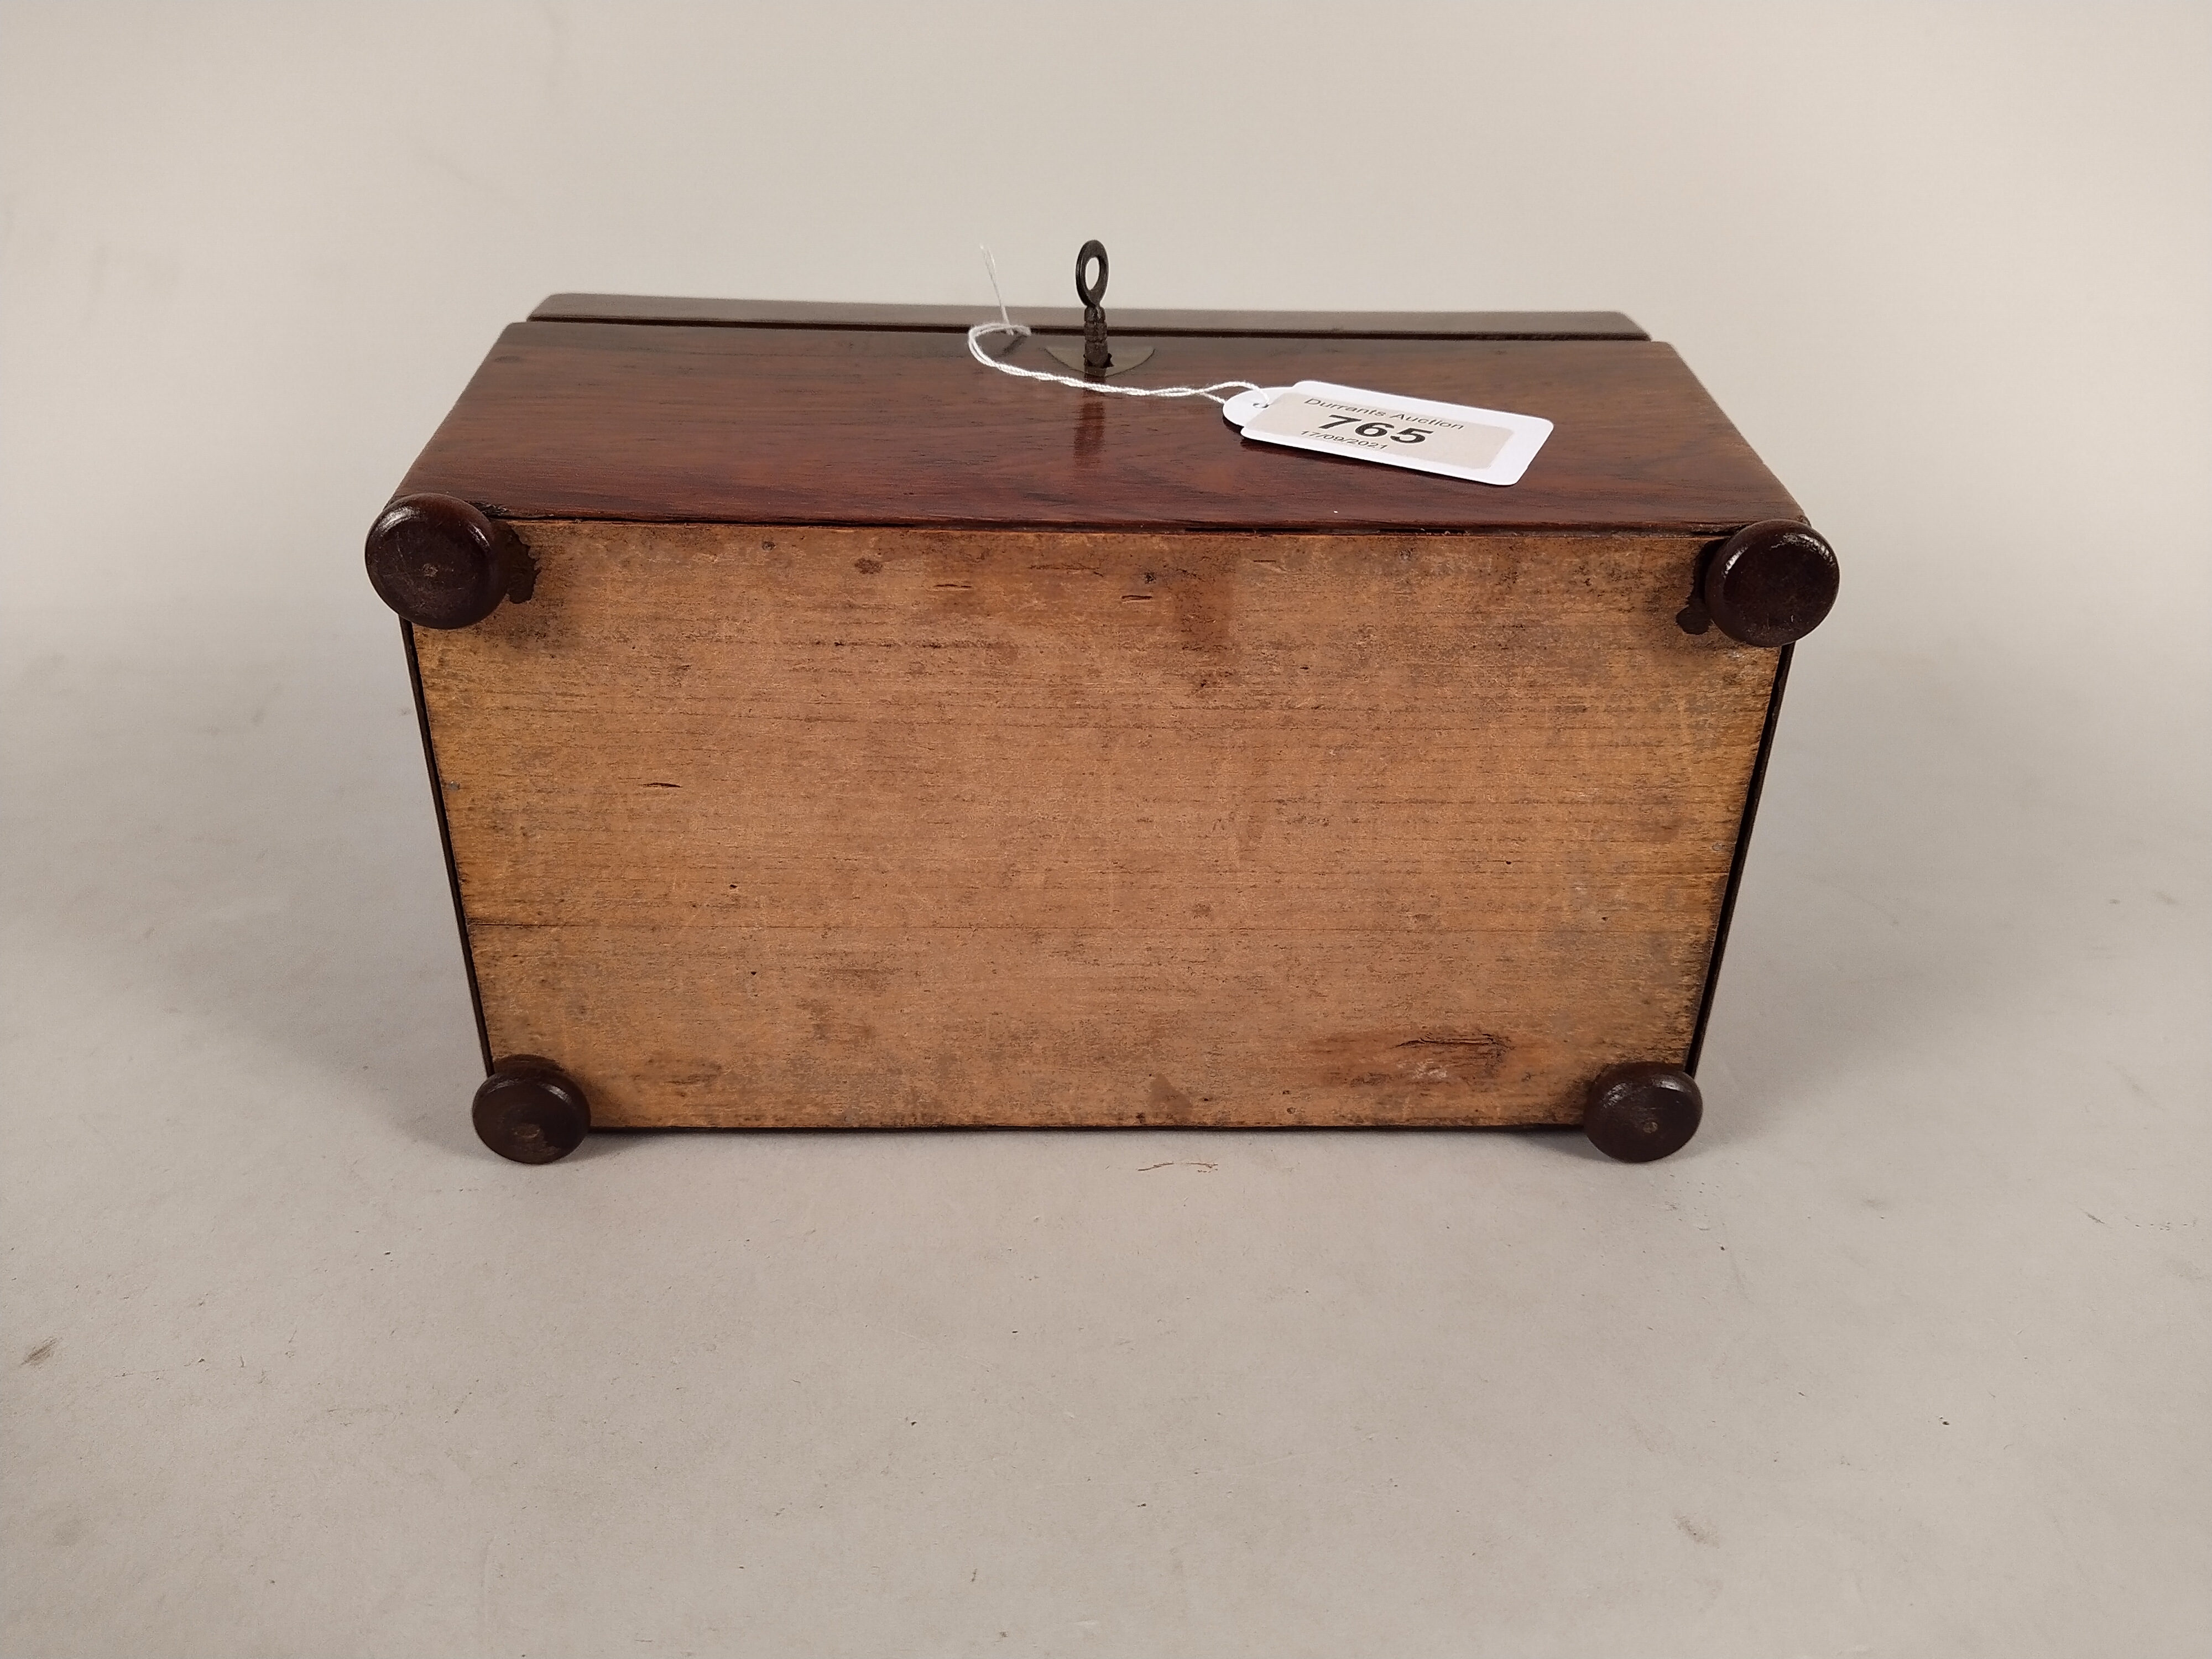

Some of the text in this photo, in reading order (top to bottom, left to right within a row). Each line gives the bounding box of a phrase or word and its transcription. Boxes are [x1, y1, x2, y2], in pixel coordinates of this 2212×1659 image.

[1304, 398, 1464, 430] Durrants Auction
[1318, 414, 1434, 444] 765
[1300, 430, 1388, 450] 17/09/2021
